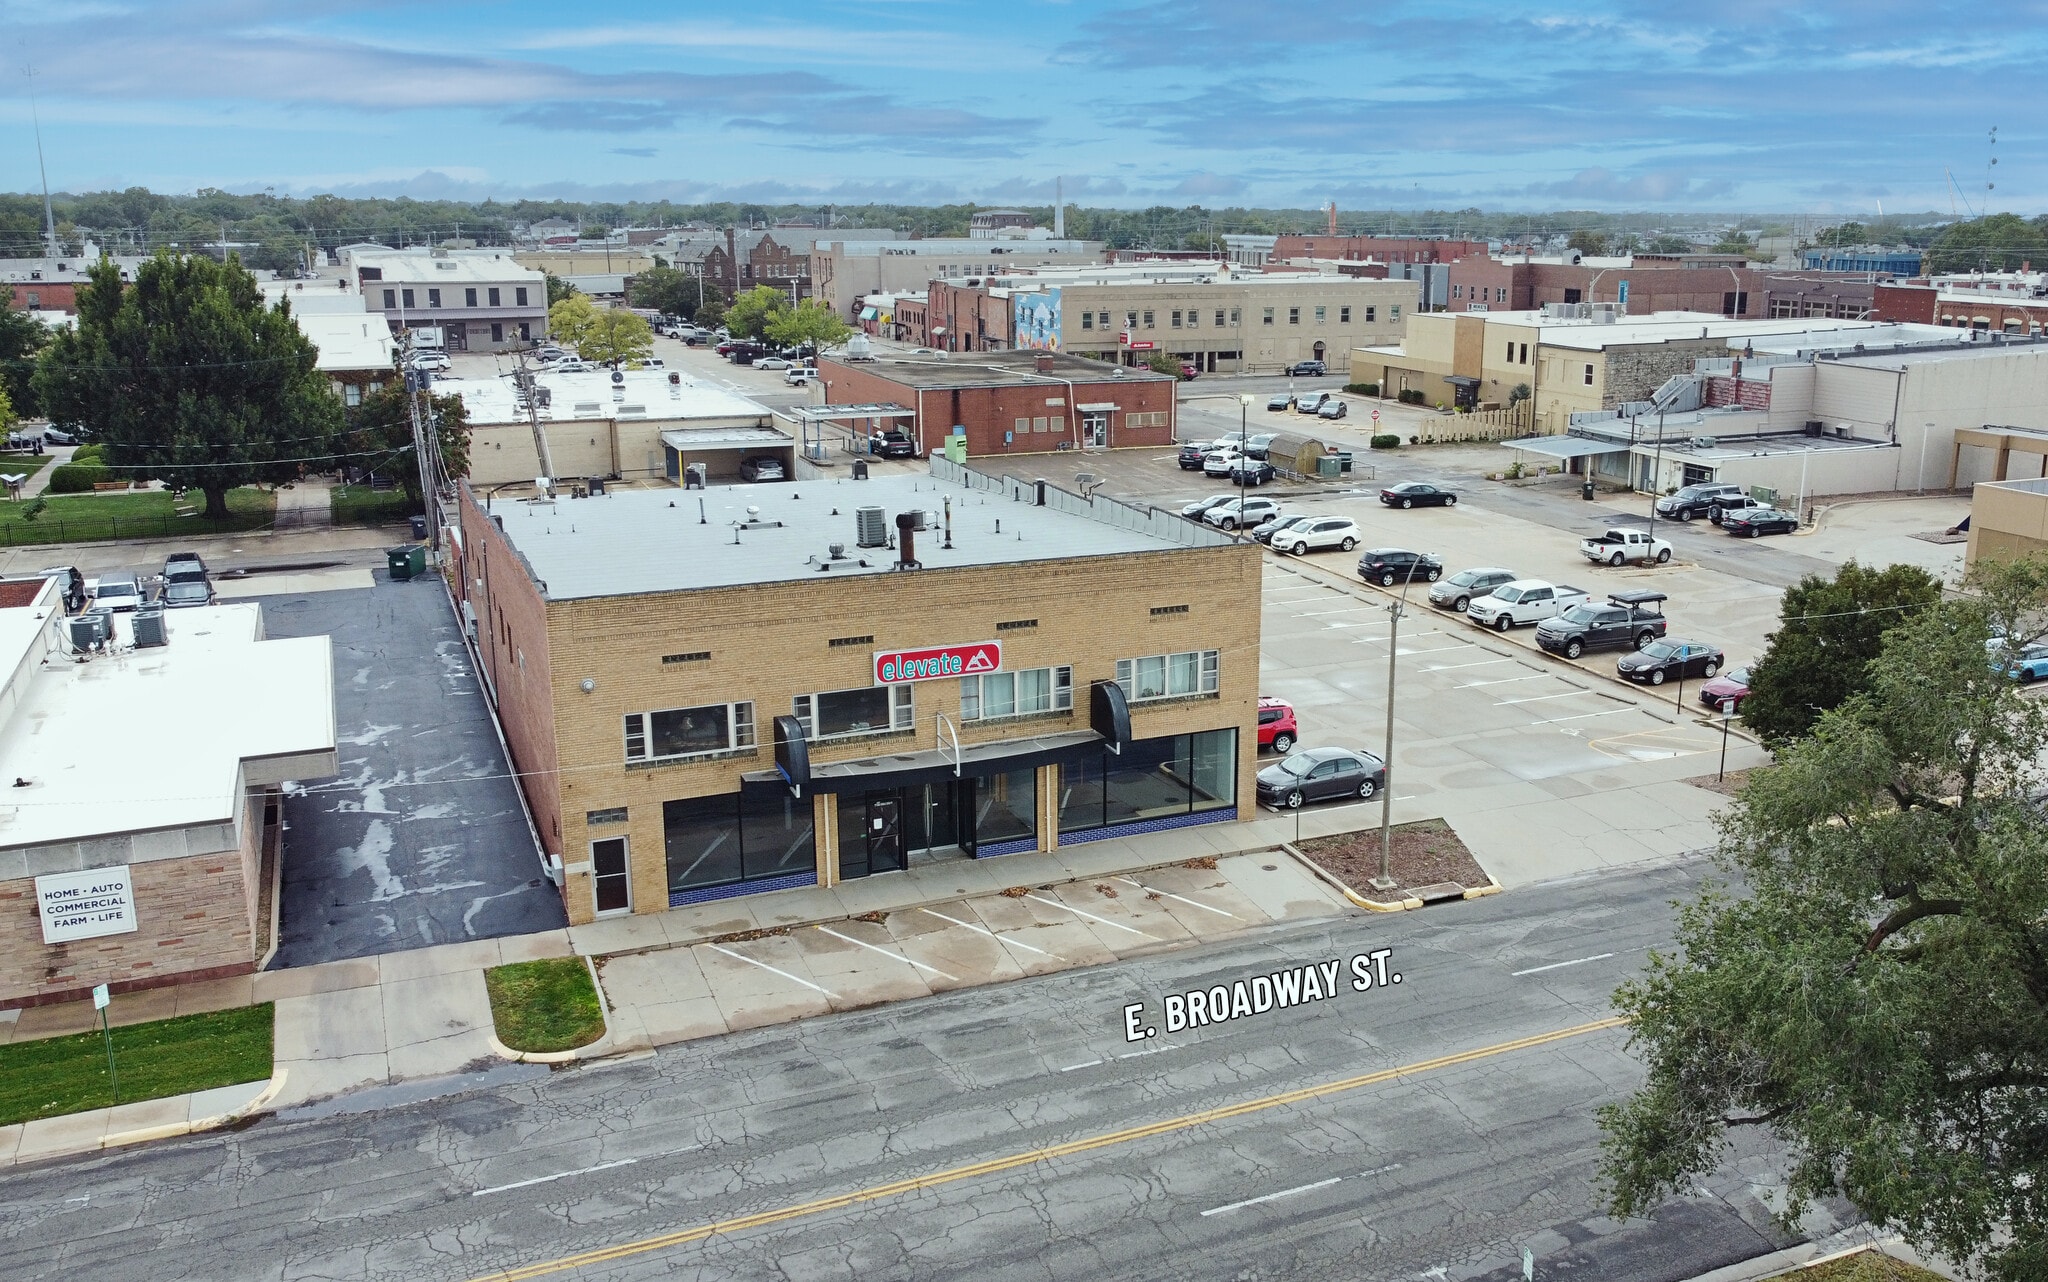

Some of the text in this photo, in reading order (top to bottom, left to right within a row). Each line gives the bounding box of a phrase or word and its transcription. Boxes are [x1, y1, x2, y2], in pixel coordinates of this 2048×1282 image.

[883, 653, 962, 680] elevate
[45, 883, 123, 900] HOME AUTO
[47, 897, 126, 914] COMMERCIAL
[54, 911, 123, 928] FARM LIFE
